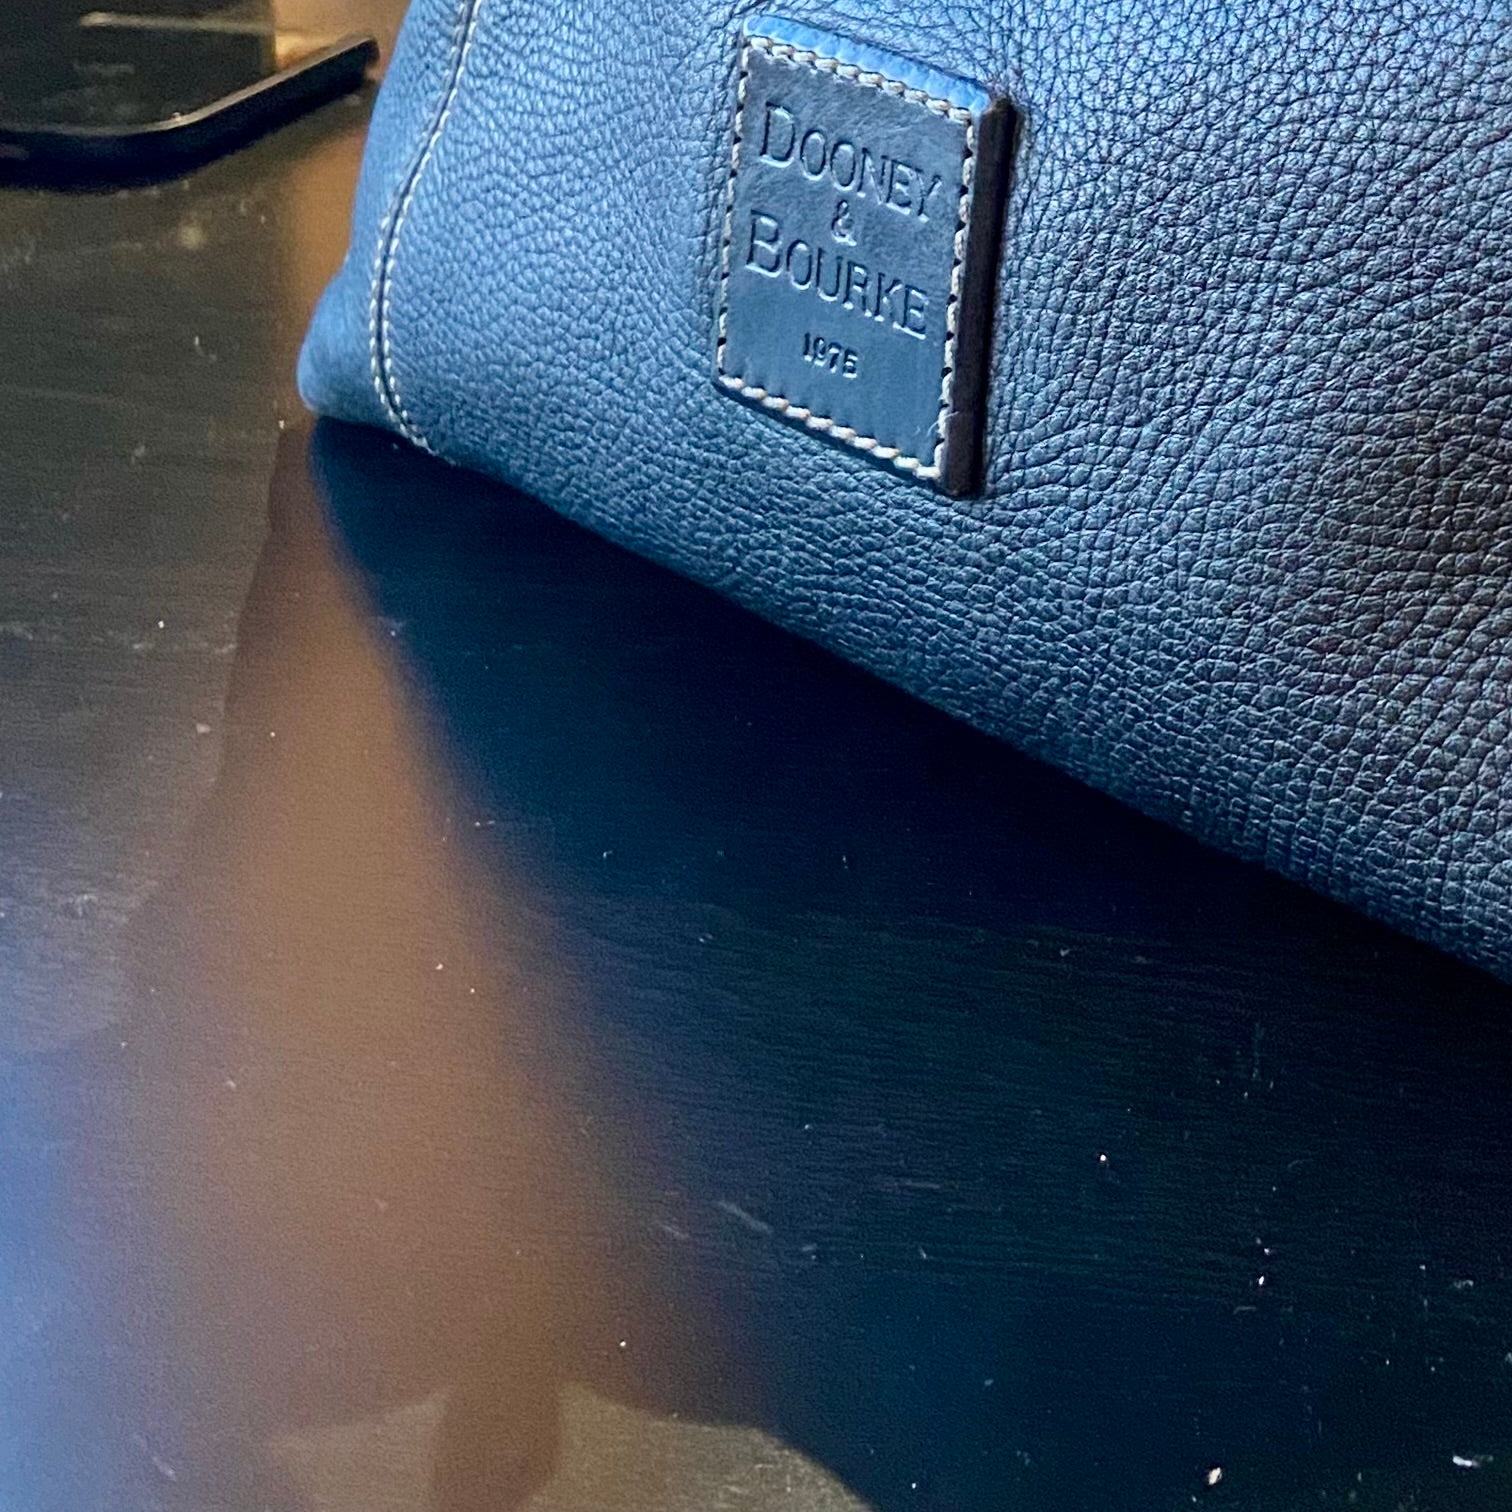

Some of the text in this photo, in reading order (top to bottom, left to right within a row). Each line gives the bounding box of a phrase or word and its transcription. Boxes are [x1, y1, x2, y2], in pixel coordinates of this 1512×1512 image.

[759, 101, 941, 222] DOONEY
[830, 199, 857, 247] &
[744, 209, 928, 340] BOURKE
[801, 331, 859, 379] 1975
